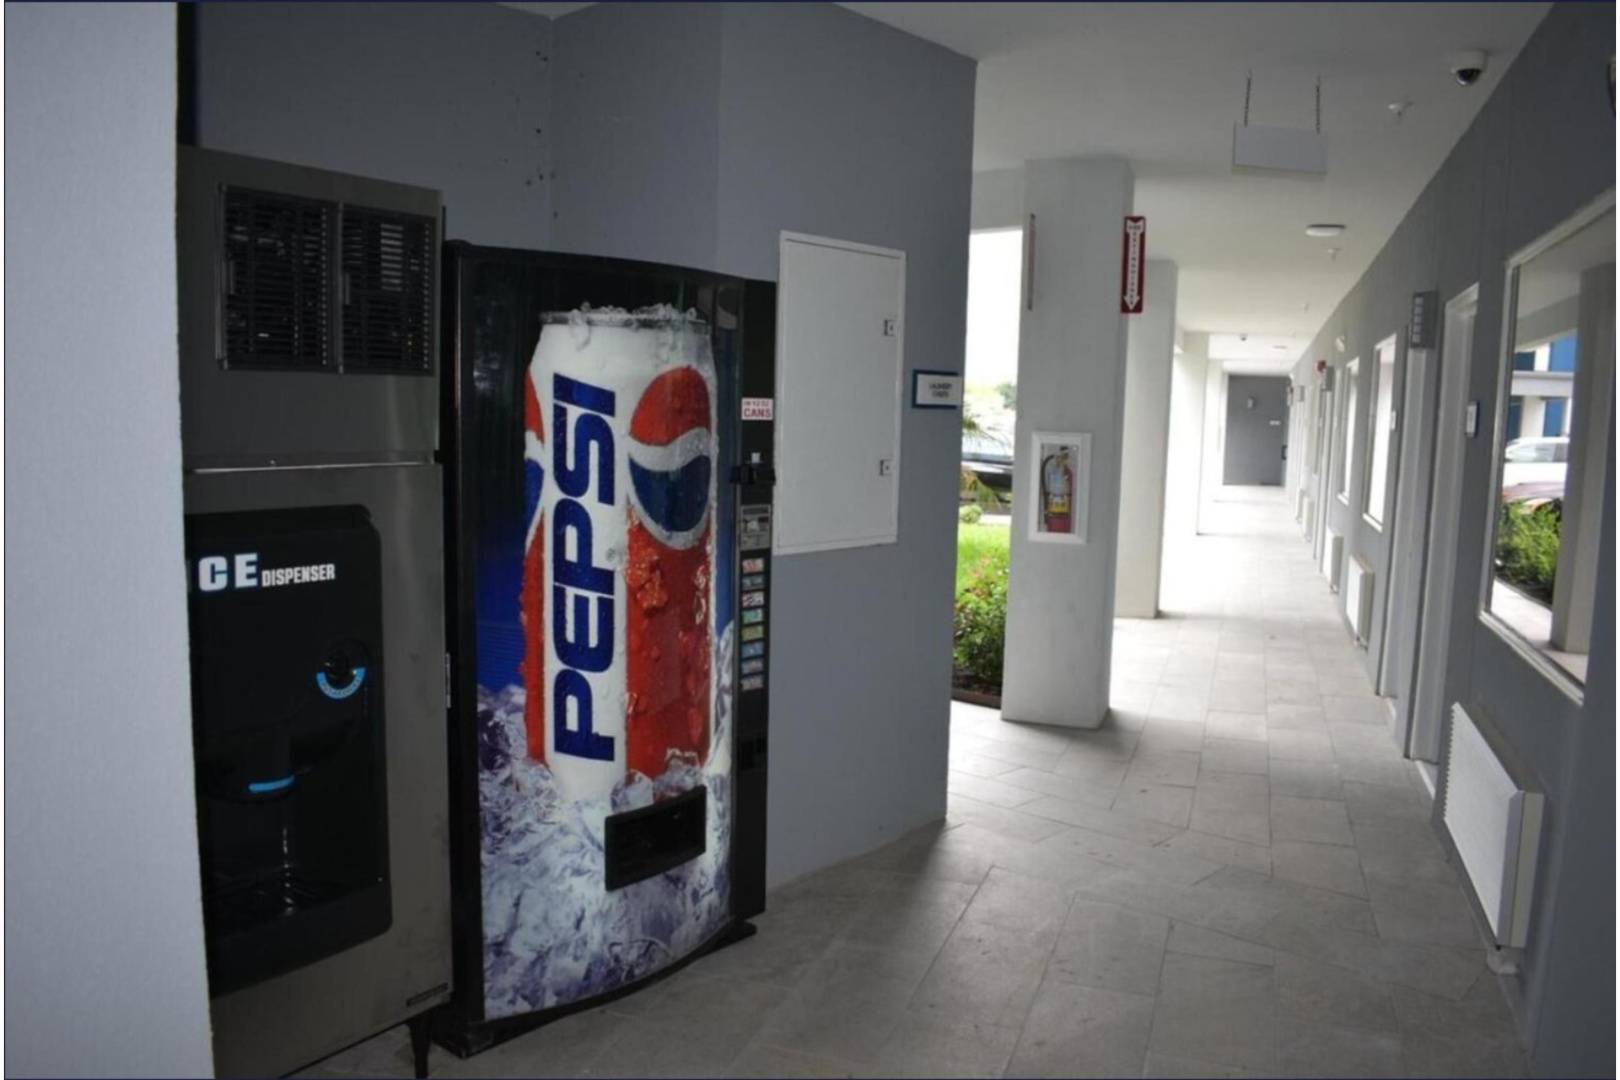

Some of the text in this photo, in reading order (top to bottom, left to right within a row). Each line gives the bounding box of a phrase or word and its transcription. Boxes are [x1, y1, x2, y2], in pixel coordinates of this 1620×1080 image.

[743, 408, 771, 418] CANS
[187, 552, 336, 593] CE DISPENSER
[553, 372, 616, 762] PEPSI
